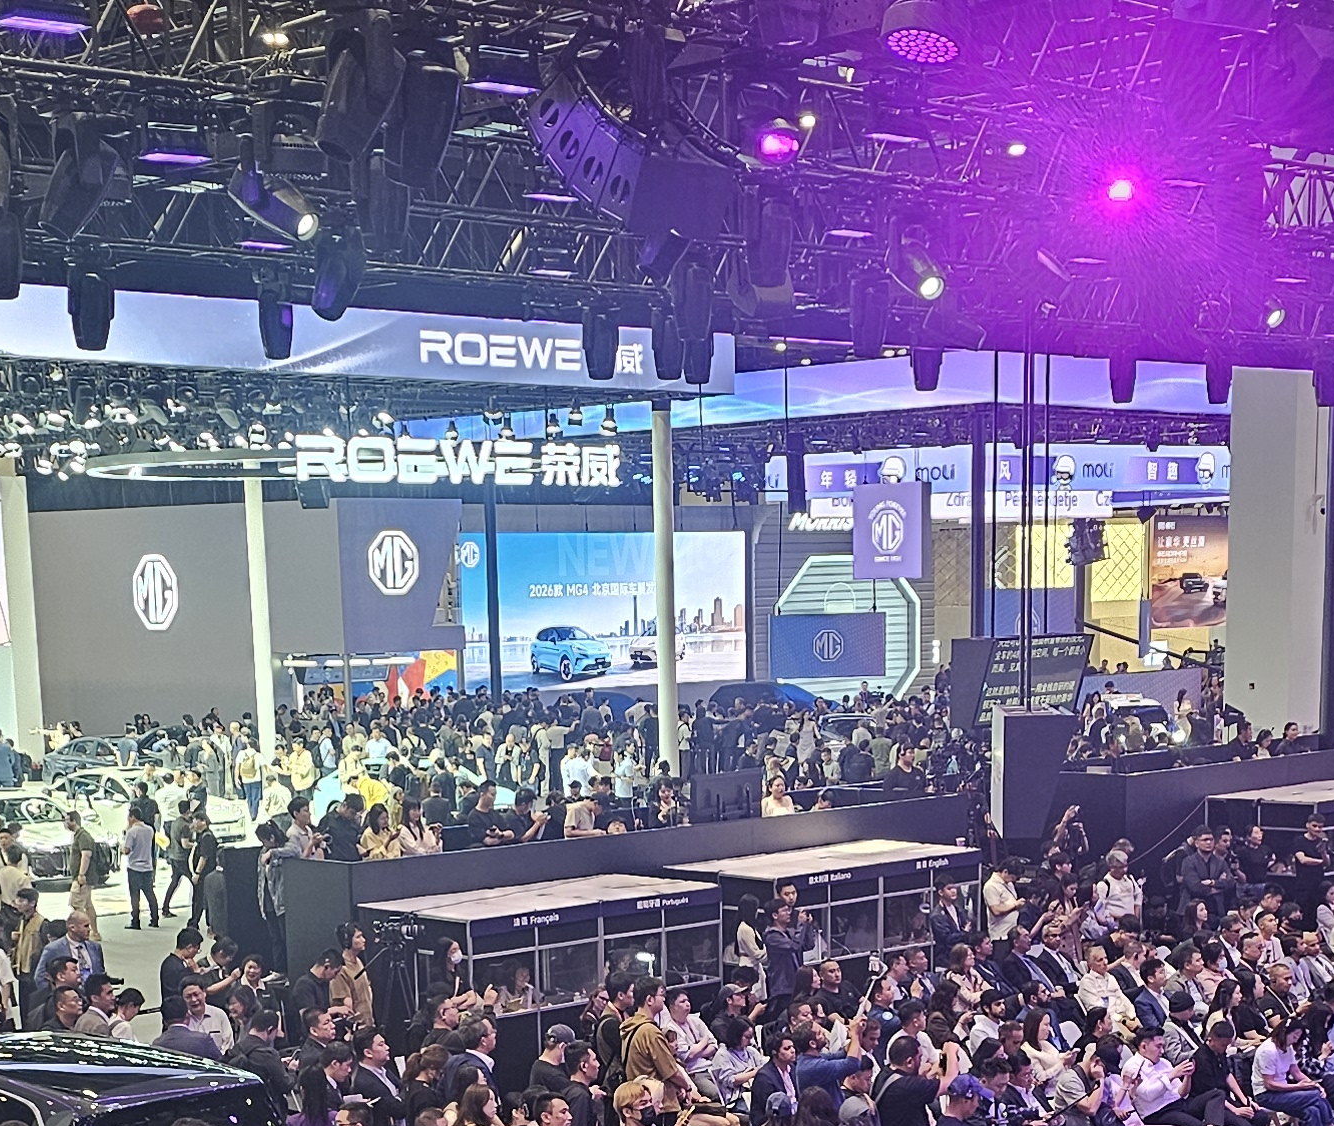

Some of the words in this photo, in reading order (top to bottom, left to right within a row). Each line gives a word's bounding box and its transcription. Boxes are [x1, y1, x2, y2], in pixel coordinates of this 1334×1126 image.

[419, 330, 582, 371] ROEWE
[615, 343, 644, 374] 威
[295, 435, 534, 485] ROEWE
[540, 442, 621, 487] 荣威
[873, 512, 903, 551] MG
[371, 535, 415, 589] MG
[461, 542, 480, 566] MG
[557, 533, 656, 577] NEW
[136, 559, 175, 625] MG
[529, 583, 564, 598] 2026款
[566, 583, 588, 597] MG4
[815, 632, 841, 660] MG
[928, 858, 949, 868] English
[529, 912, 560, 925] Français
